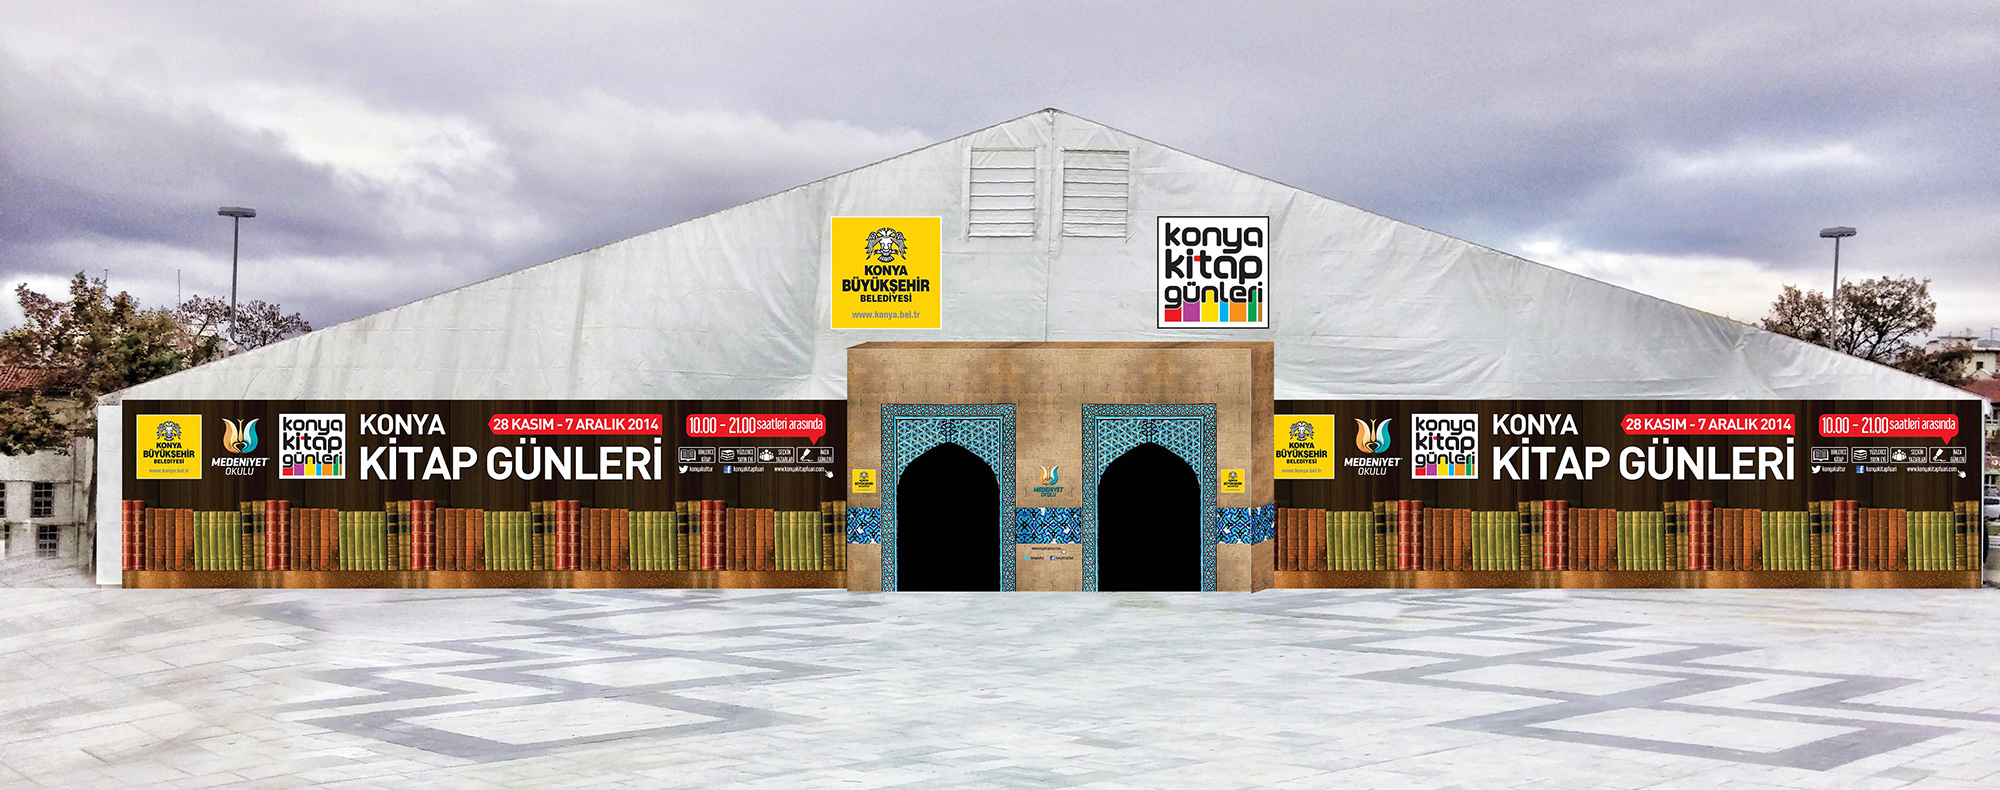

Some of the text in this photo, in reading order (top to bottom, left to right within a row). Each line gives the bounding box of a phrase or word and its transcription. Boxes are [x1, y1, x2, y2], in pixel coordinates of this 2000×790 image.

[1165, 222, 1263, 254] konya
[864, 265, 908, 276] KONYA
[1165, 248, 1262, 285] kitap
[842, 276, 930, 294] BÜYÜKŞEHİR
[860, 293, 912, 303] BELEDİYESİ
[1164, 281, 1263, 310] günleri
[851, 310, 921, 321] www.konya.bel.tr
[282, 416, 342, 435] konya
[360, 414, 446, 435] KONYA
[493, 418, 509, 430] 28
[512, 418, 554, 430] KASIM
[566, 418, 573, 430] 7
[575, 418, 625, 430] ARALIK
[628, 418, 659, 430] 2014
[689, 416, 717, 434] 10.00
[729, 416, 756, 434] 21.00
[756, 417, 788, 430] saatleri
[789, 417, 823, 430] arasında
[1415, 416, 1475, 435] konya
[1493, 414, 1579, 435] KONYA
[1626, 418, 1642, 430] 28
[1644, 418, 1687, 430] KASIM
[1699, 418, 1706, 430] 7
[1708, 418, 1758, 430] ARALIK
[1761, 418, 1792, 430] 2014
[1822, 416, 1850, 434] 10.00
[1861, 416, 1889, 434] 21.00
[1889, 417, 1920, 430] saatleri
[1922, 417, 1956, 430] arasında
[283, 432, 342, 453] kitap
[1415, 432, 1475, 453] kitap
[143, 449, 195, 460] BÜYÜKŞEHİR
[282, 452, 342, 468] günleri
[360, 437, 662, 480] KİTAP GÜNLERİ
[1276, 449, 1328, 460] BÜYÜKŞEHİR
[1415, 452, 1475, 468] günleri
[1493, 437, 1795, 480] KİTAP GÜNLERİ
[225, 467, 254, 476] OKULU
[1358, 467, 1387, 476] OKULU
